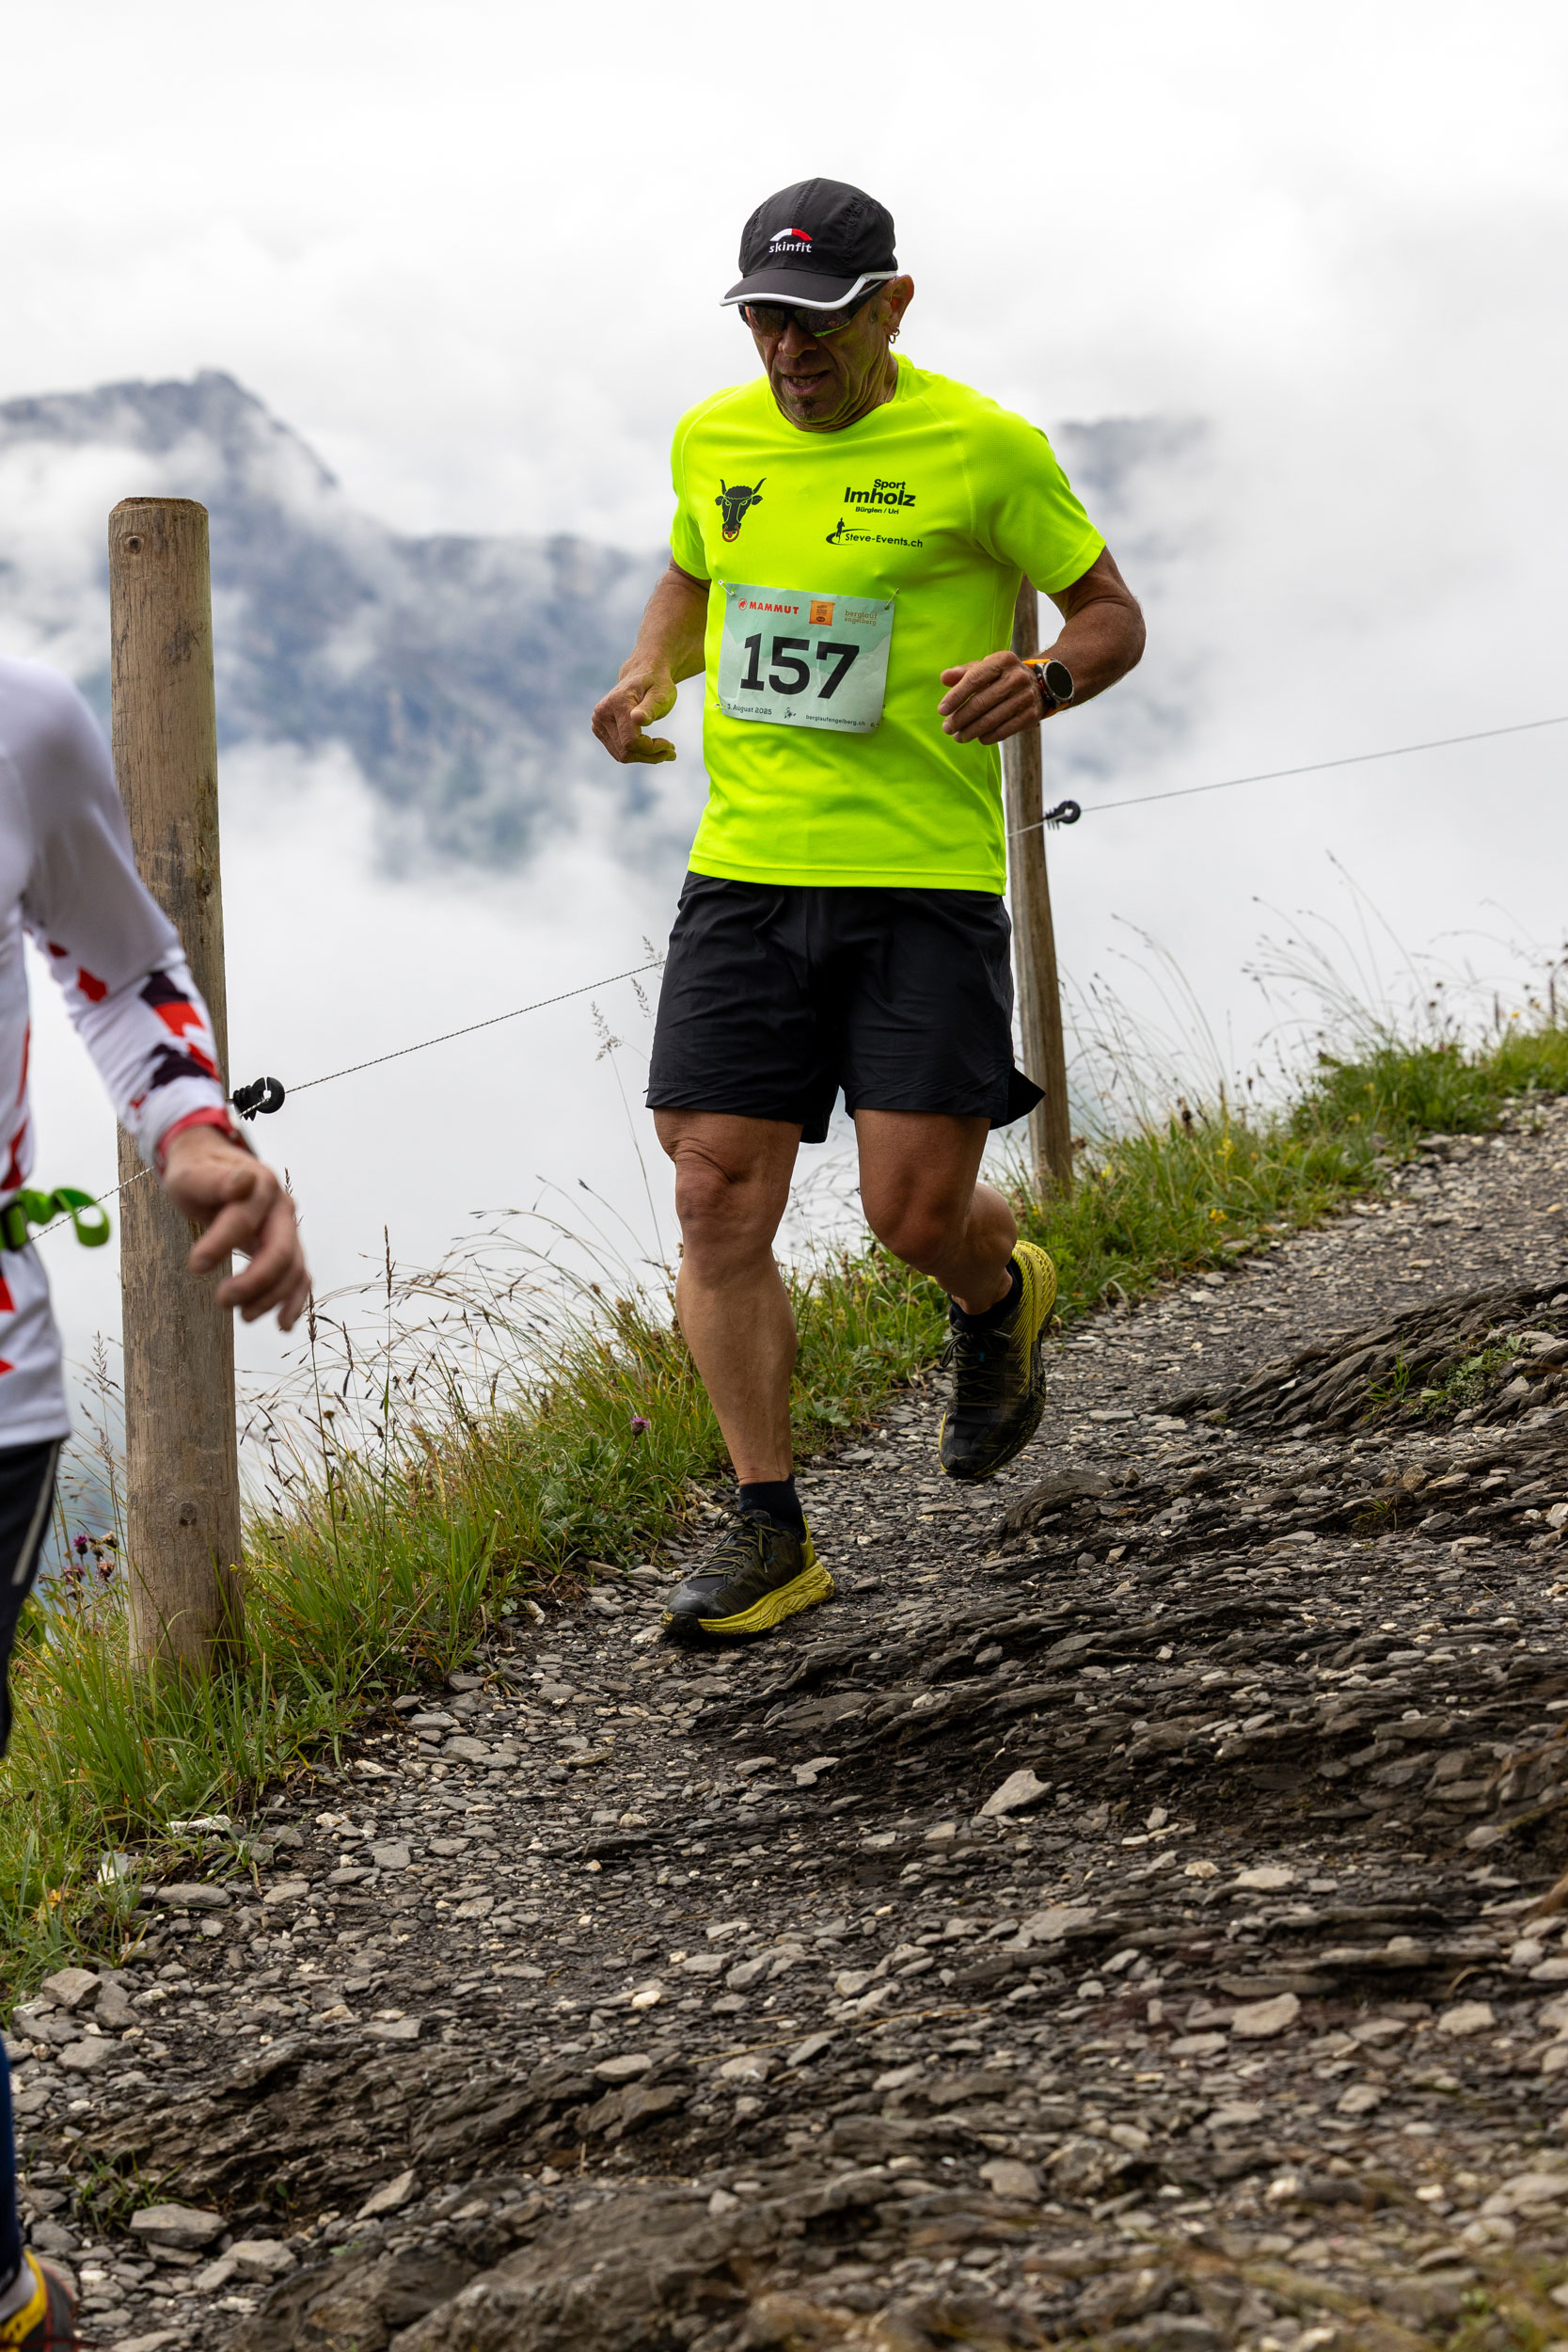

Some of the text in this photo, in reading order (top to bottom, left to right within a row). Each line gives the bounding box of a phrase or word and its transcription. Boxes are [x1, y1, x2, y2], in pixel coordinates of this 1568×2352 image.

[768, 242, 812, 253] skinfit
[874, 479, 906, 490] Sport
[844, 487, 916, 507] Imholz
[855, 506, 882, 515] Bürglen
[845, 532, 923, 548] Steve-Events.ch
[749, 601, 800, 614] MAMMUT
[845, 610, 878, 620] berglauf
[845, 617, 877, 627] engelberg
[740, 632, 860, 699] 157
[733, 704, 753, 713] August
[805, 715, 866, 726] berglaufengelberg.ch
